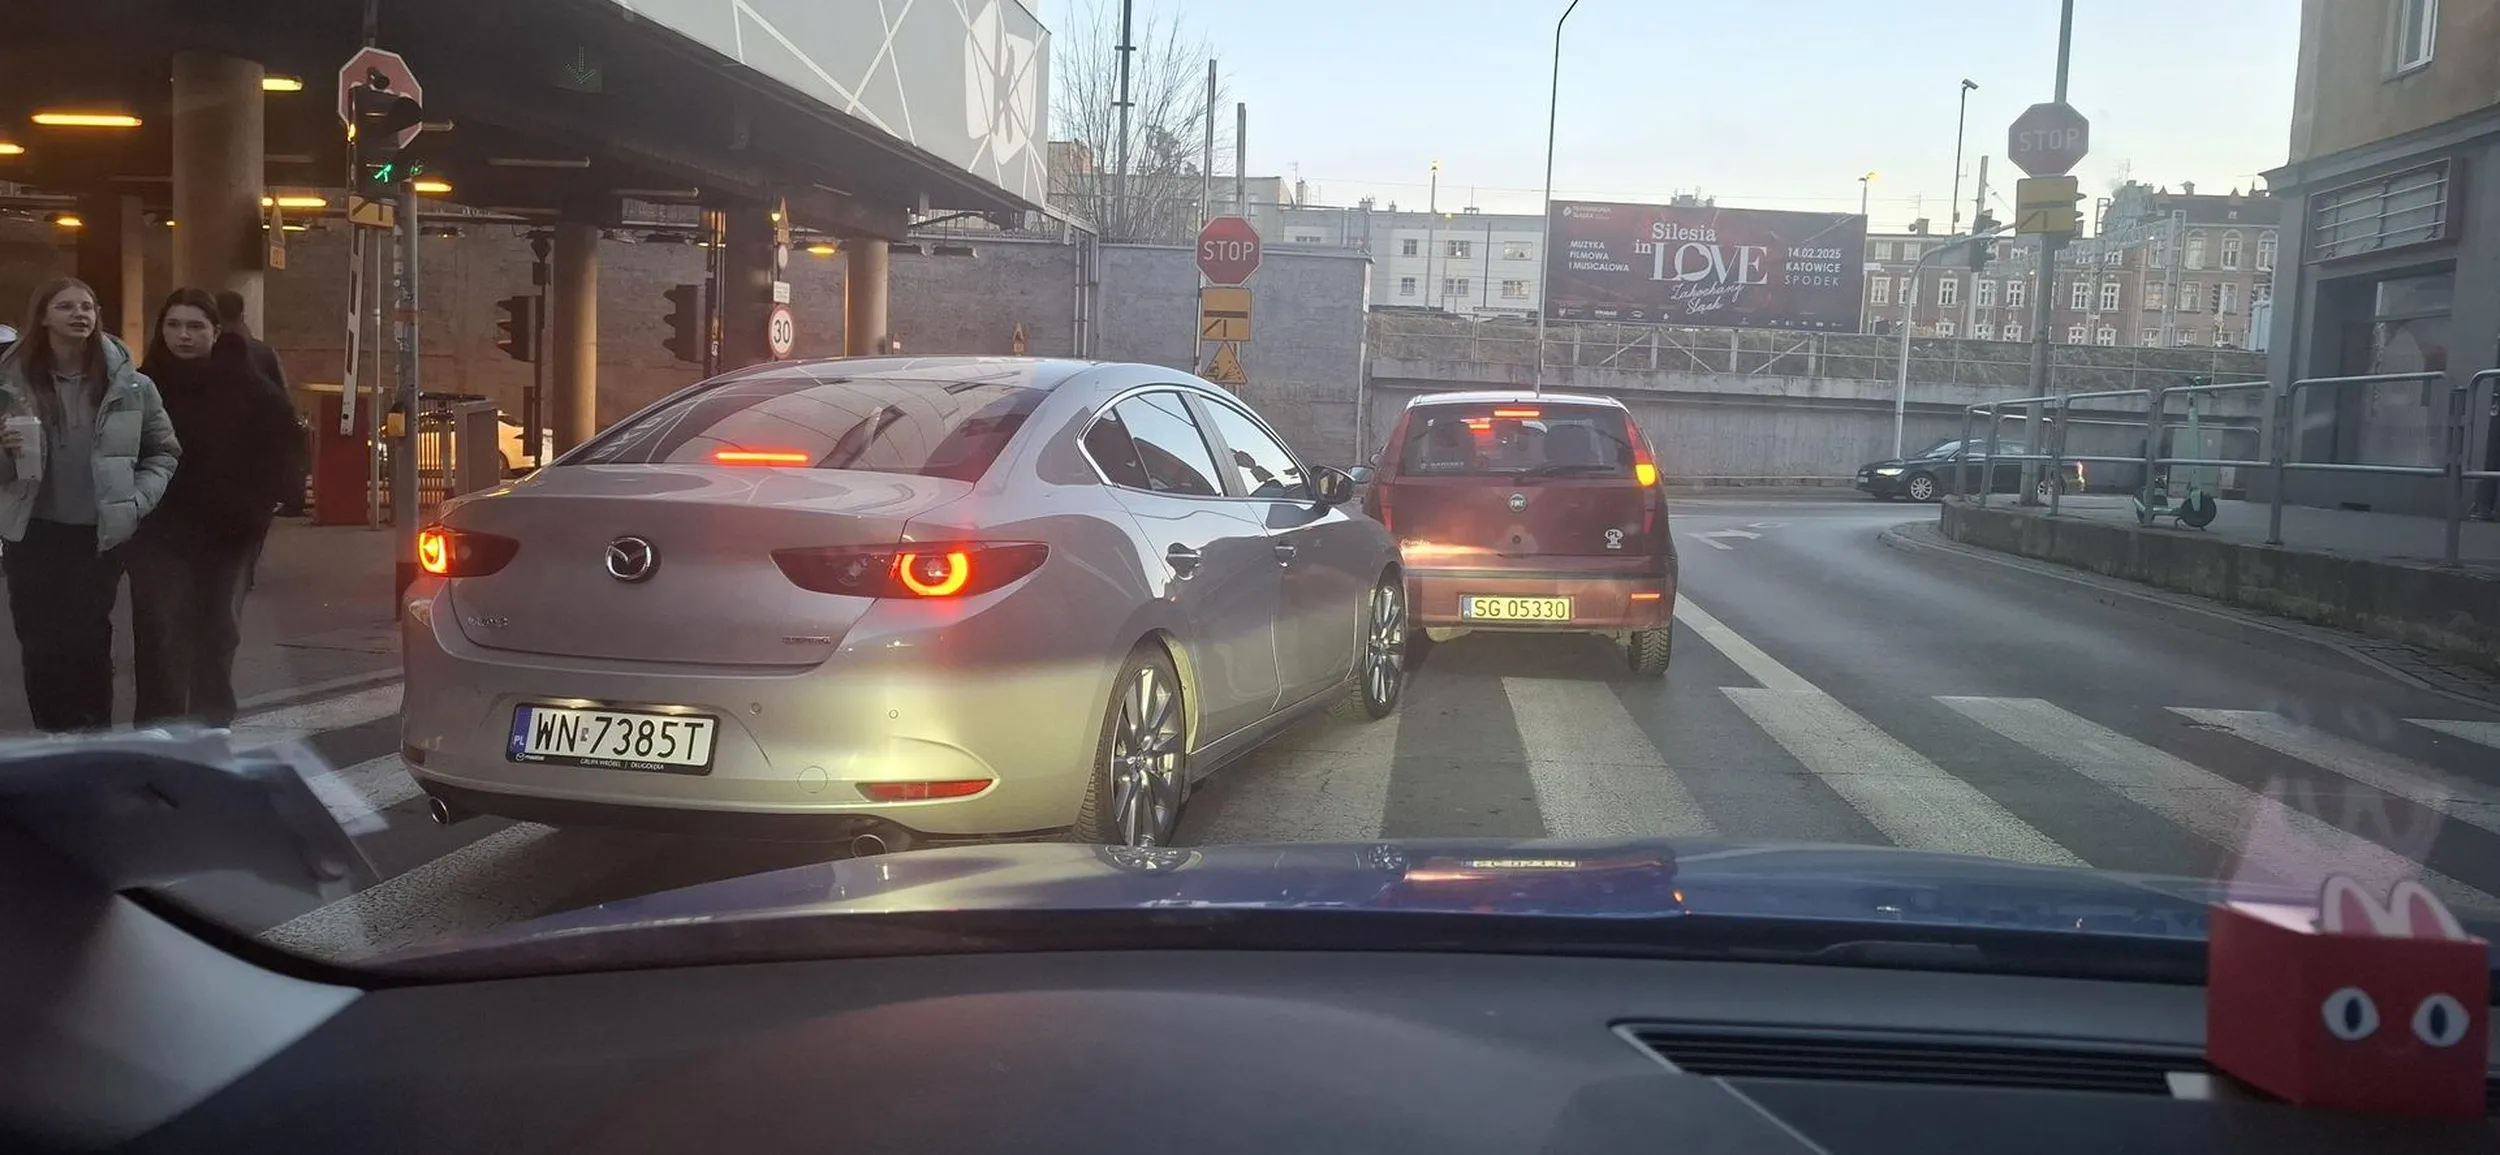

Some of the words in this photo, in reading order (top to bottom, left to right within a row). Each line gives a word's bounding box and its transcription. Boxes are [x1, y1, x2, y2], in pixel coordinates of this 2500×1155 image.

[2019, 128, 2080, 152] STOP
[1652, 222, 1716, 241] Silesia
[1203, 240, 1254, 261] STOP
[1569, 240, 1605, 249] MUZYKA
[1569, 251, 1609, 260] FILMOWA
[1787, 247, 1842, 259] 14.02.2025
[1568, 262, 1572, 271] I
[1635, 239, 1652, 253] in
[1649, 242, 1768, 285] LOVE
[1785, 261, 1841, 273] KATOWICE
[1784, 274, 1839, 287] SPODEK
[773, 319, 791, 344] 30
[1475, 600, 1501, 617] SG
[1508, 600, 1566, 618] 05330
[513, 735, 525, 746] PL
[534, 712, 580, 752] WN
[589, 715, 704, 760] 7385T
